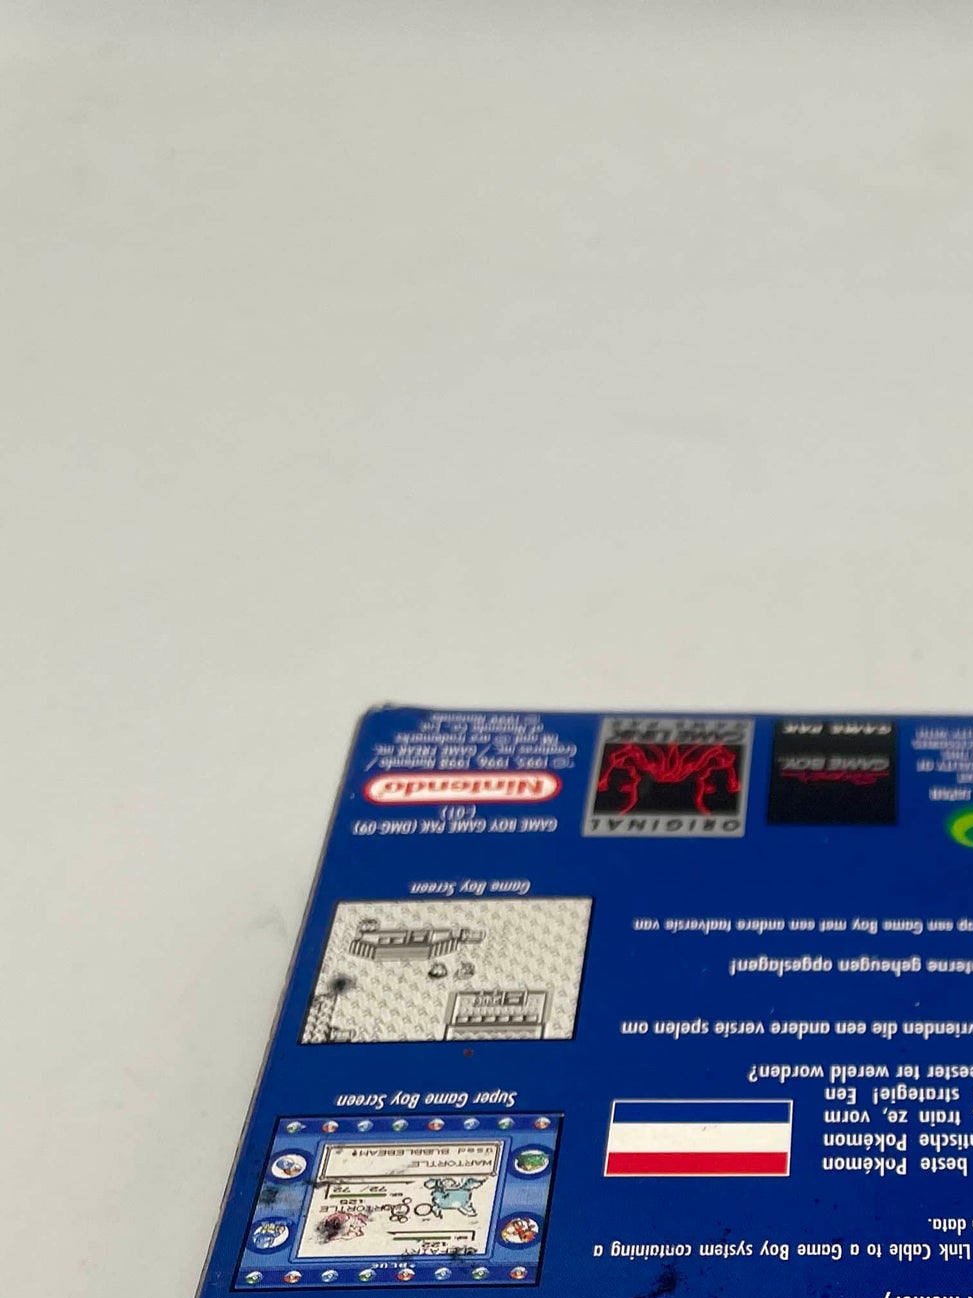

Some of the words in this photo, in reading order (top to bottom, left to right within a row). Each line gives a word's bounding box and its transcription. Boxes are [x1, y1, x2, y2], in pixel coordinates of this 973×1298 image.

[826, 755, 889, 771] GAME
[382, 778, 544, 796] Nintendo
[589, 817, 740, 831] ORIGINAL
[410, 881, 456, 896] Screen
[459, 879, 487, 896] Boy
[489, 879, 531, 895] Game
[336, 1093, 387, 1110] Screen
[389, 1090, 420, 1109] Boy
[424, 1092, 468, 1108] Game
[472, 1088, 517, 1107] Super
[824, 1087, 856, 1105] Een
[872, 1083, 960, 1104] strategie!
[409, 1158, 492, 1168] WARTORTLE
[927, 1217, 967, 1236] data.
